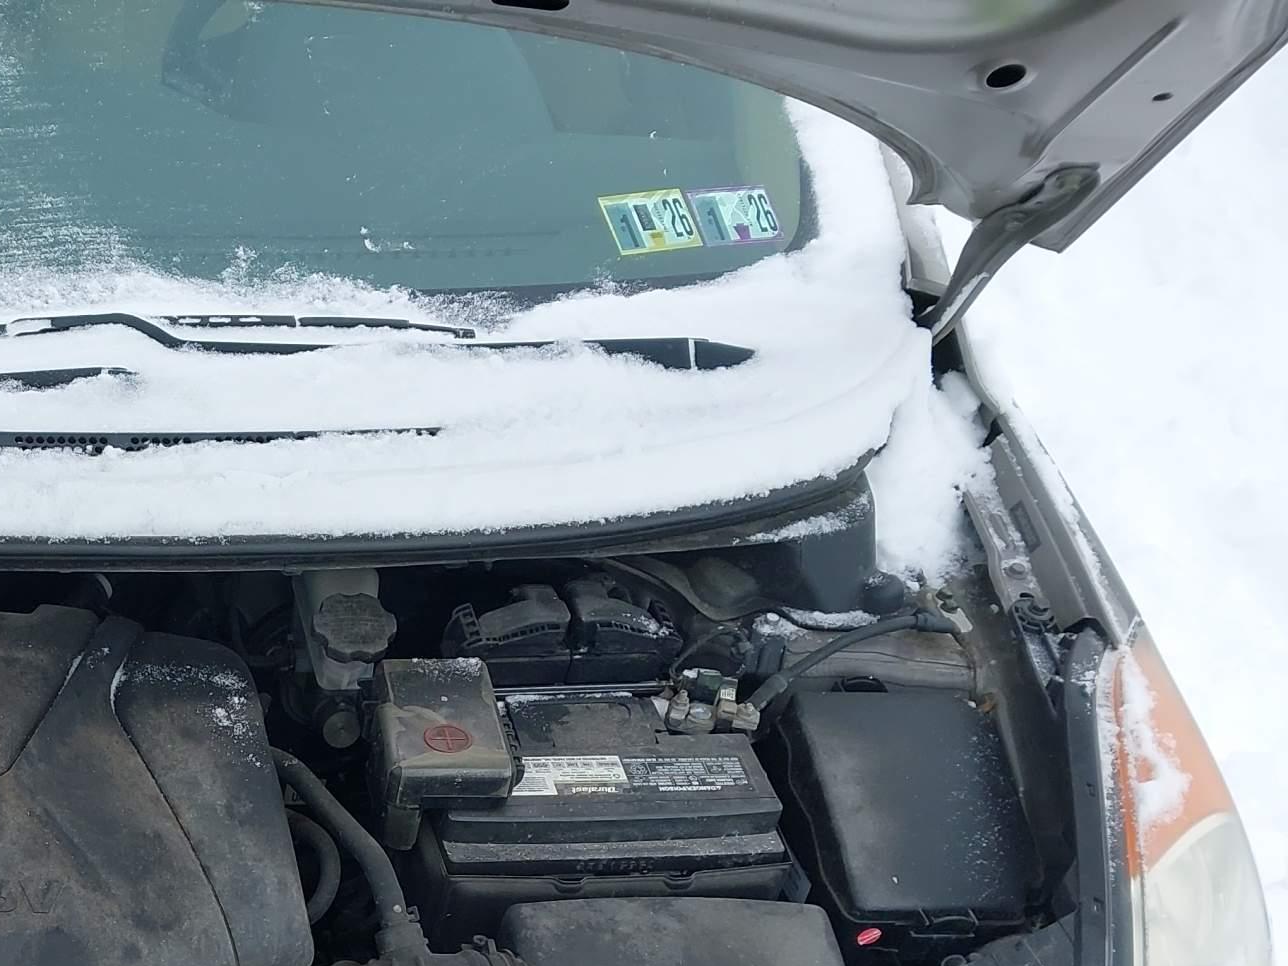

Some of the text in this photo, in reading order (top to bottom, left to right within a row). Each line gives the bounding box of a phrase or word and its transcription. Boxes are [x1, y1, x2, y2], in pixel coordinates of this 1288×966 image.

[663, 198, 694, 237] 26
[748, 193, 778, 232] 26
[571, 785, 619, 794] Duralast
